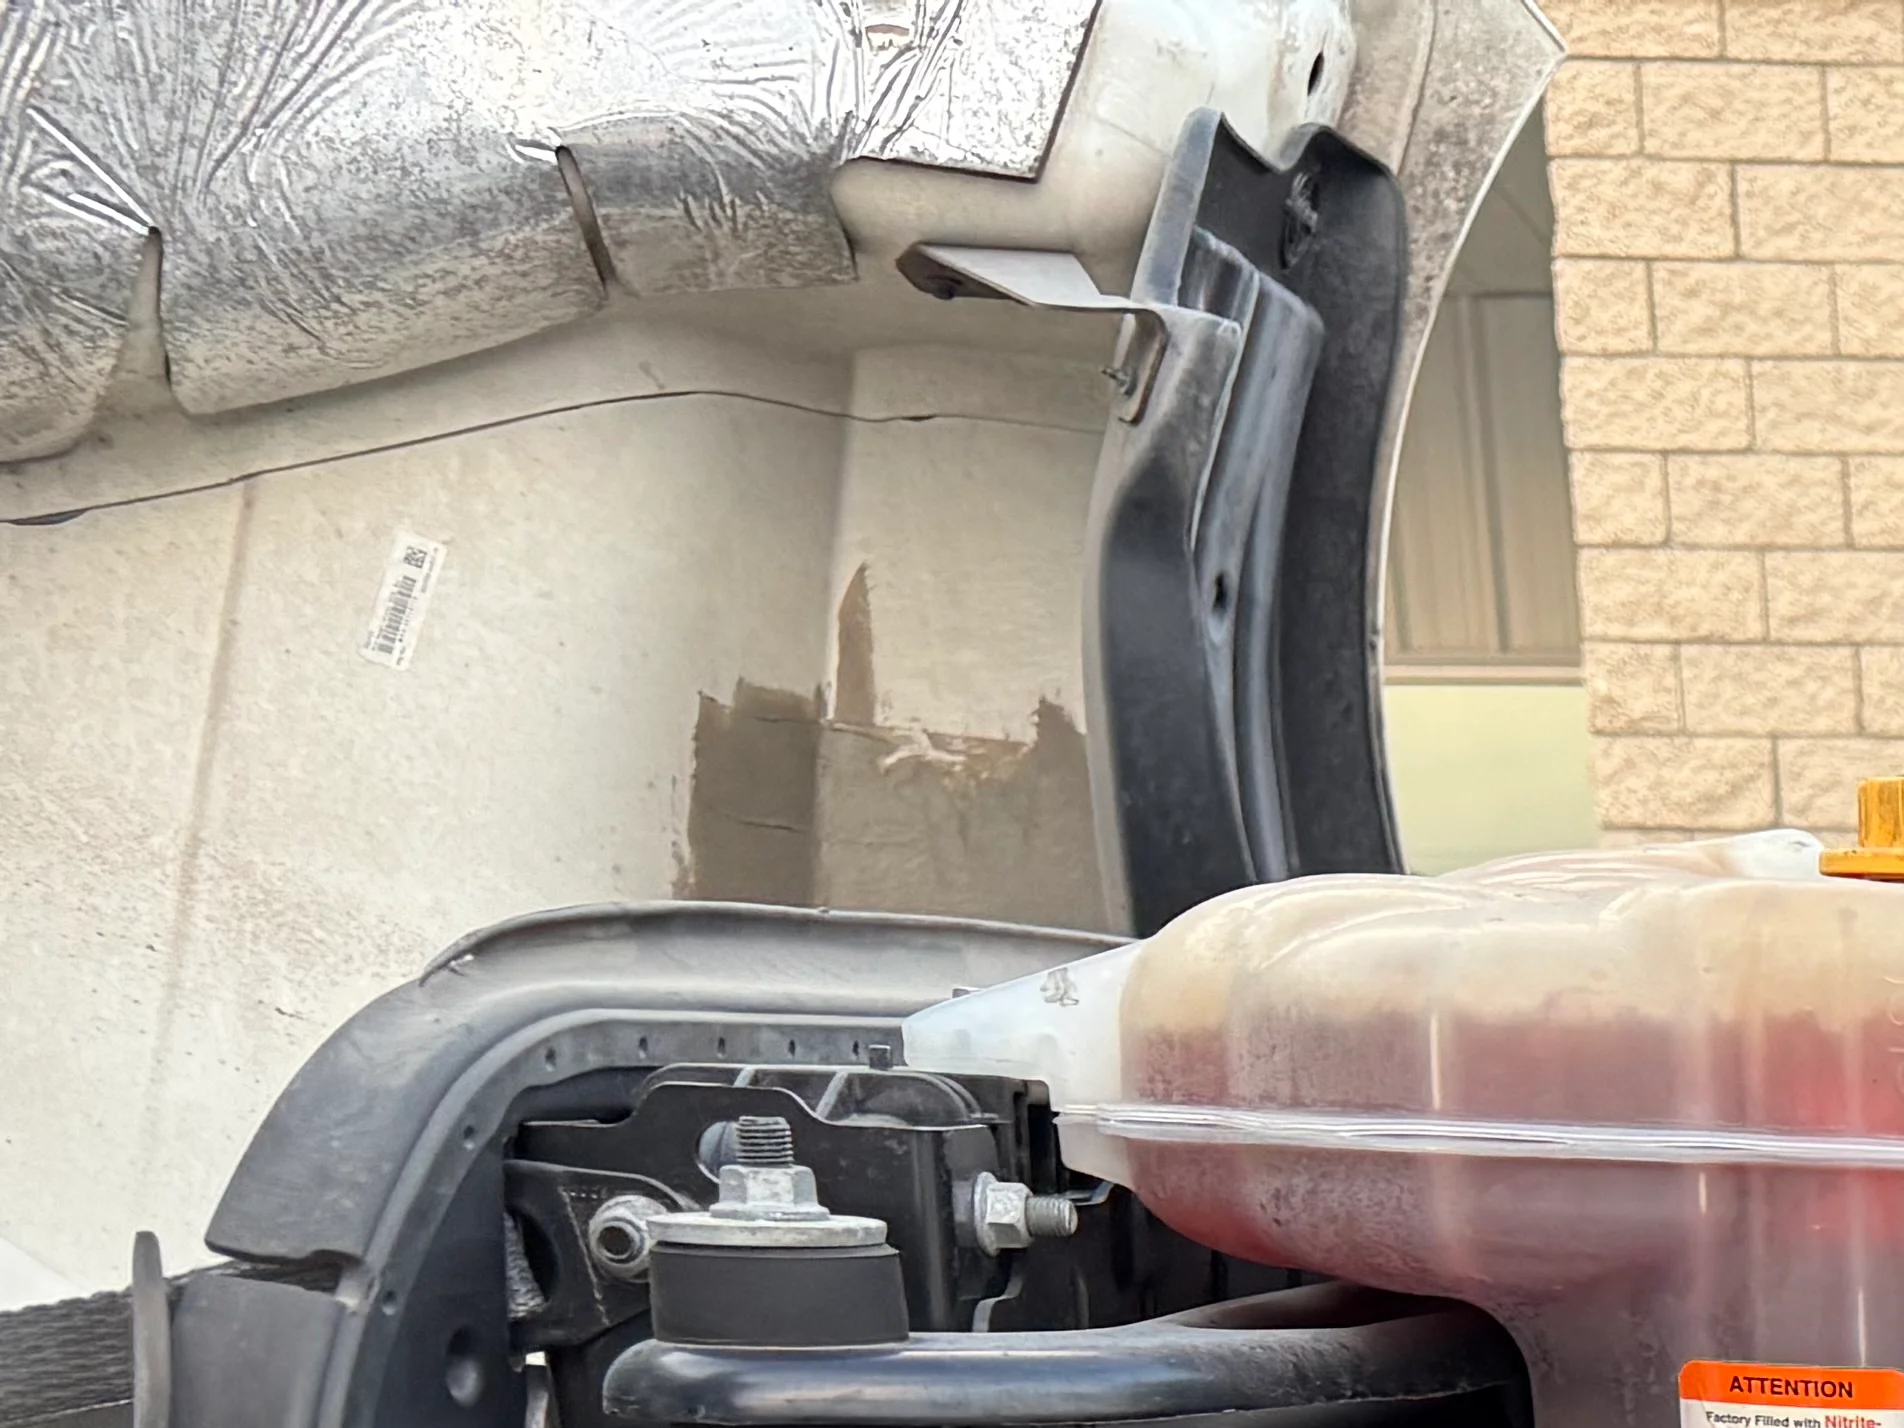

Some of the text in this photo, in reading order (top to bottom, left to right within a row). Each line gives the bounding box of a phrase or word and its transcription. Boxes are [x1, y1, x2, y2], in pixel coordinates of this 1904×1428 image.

[1729, 1375, 1854, 1399] ATTENTION
[1705, 1411, 1751, 1428] Factory
[1755, 1414, 1789, 1428] Filled
